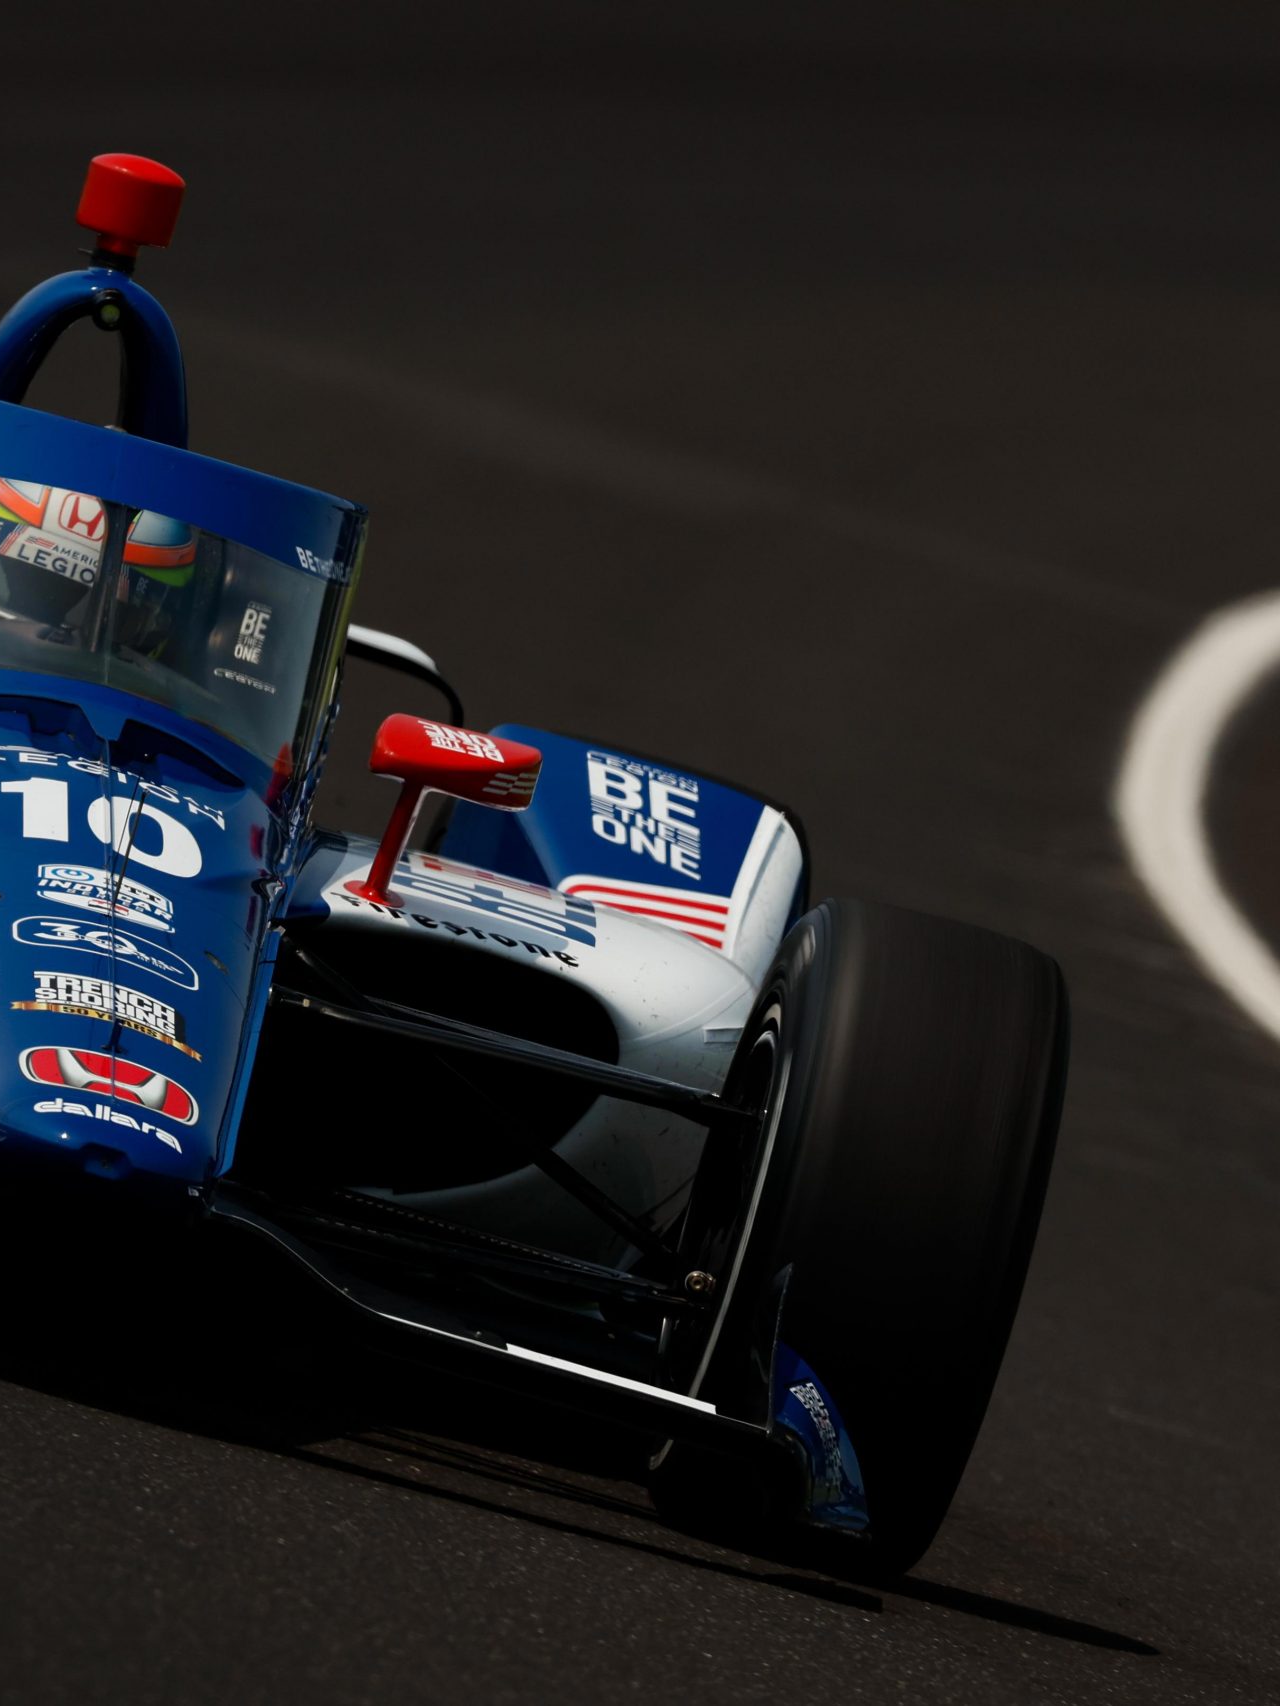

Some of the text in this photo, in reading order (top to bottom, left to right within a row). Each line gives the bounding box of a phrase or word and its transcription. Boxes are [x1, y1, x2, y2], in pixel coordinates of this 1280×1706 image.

[17, 543, 97, 585] LEGIO
[52, 544, 99, 568] AMERIC
[240, 608, 270, 640] BE
[234, 643, 262, 665] ONE
[466, 743, 504, 763] BE
[587, 759, 700, 837] BE
[0, 776, 203, 879] 10
[615, 804, 677, 846] THE
[592, 813, 701, 881] ONE
[38, 879, 174, 922] INDYCAR
[33, 921, 138, 955] 30
[330, 891, 580, 968] Firestone
[34, 971, 176, 1024] TRENCH
[35, 987, 176, 1036] SHORING
[63, 1006, 159, 1039] 50 YARS
[33, 1098, 183, 1155] dallara
